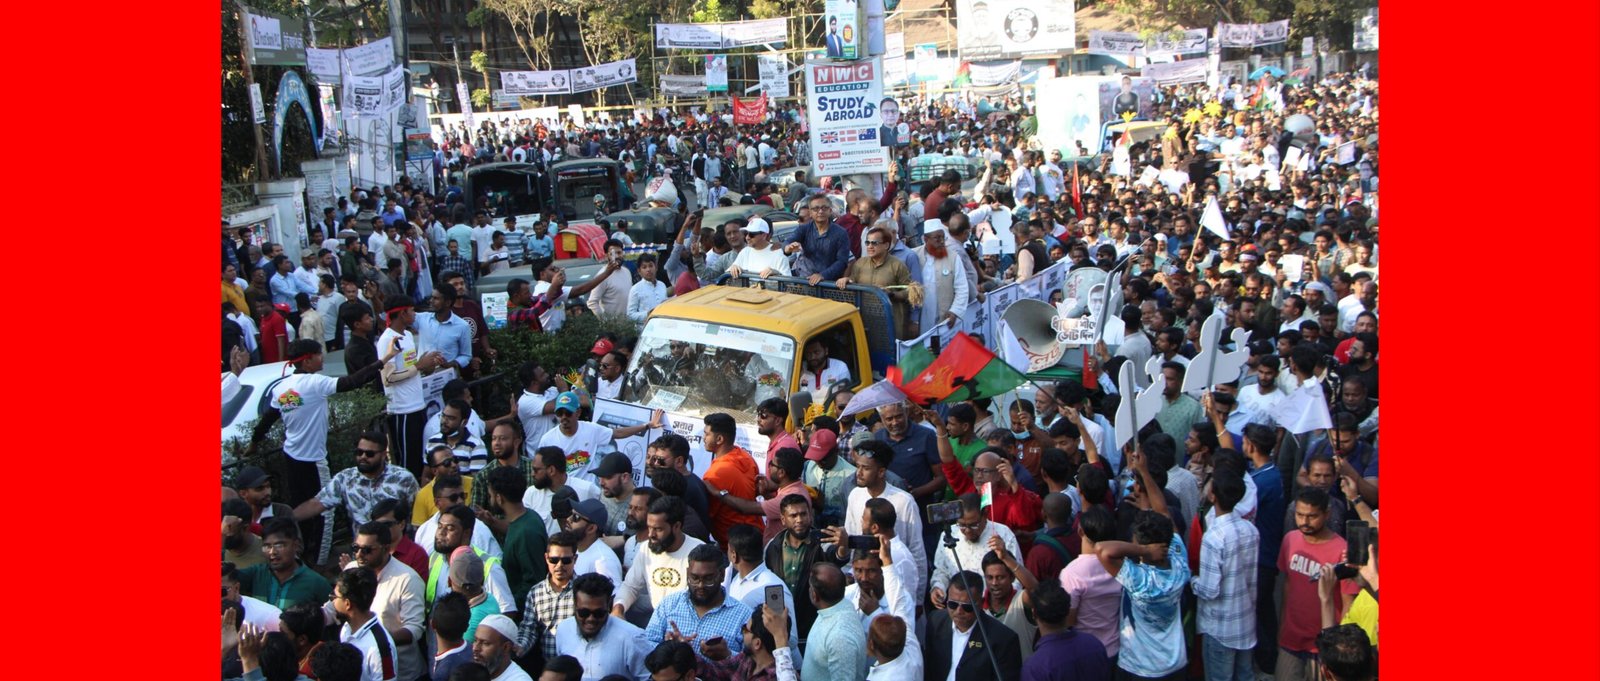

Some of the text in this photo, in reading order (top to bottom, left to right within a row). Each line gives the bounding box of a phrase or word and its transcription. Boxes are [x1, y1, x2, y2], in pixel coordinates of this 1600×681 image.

[817, 65, 869, 82] NWC
[817, 83, 868, 93] EDUCATION
[817, 96, 864, 111] STUDY
[824, 106, 873, 121] ABROAD
[1080, 330, 1094, 340] দিন
[1289, 553, 1321, 577] CALM
